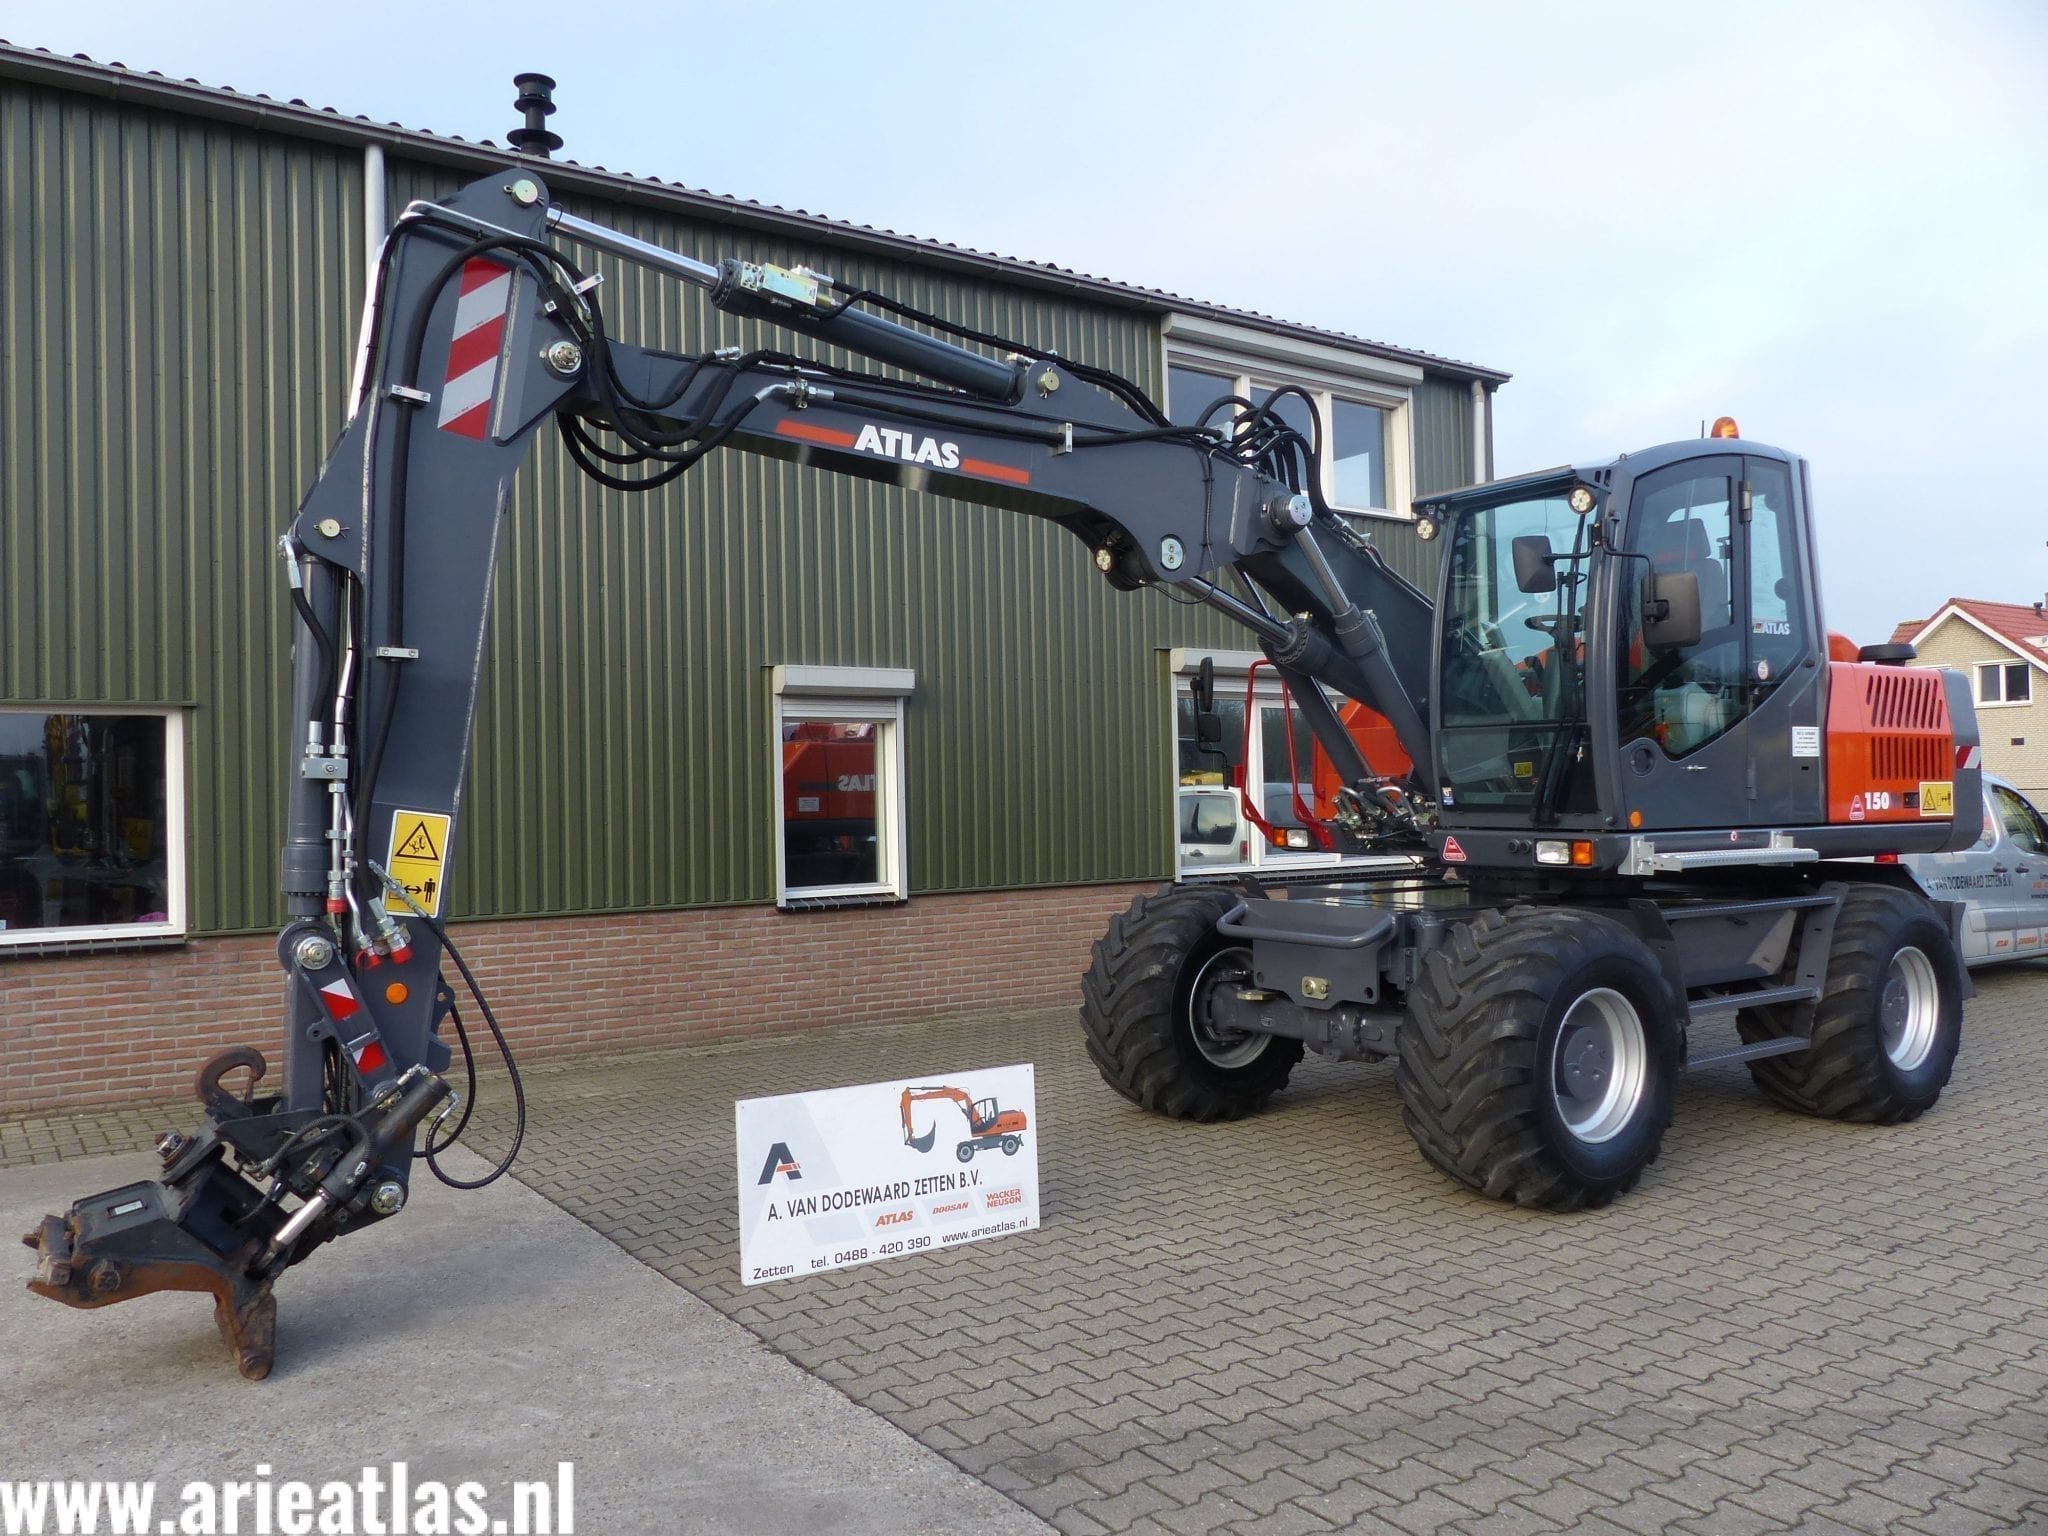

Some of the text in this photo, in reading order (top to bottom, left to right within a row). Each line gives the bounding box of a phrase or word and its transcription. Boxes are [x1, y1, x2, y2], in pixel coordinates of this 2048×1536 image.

[854, 424, 960, 469] ATLAS
[1761, 622, 1790, 635] ATLAS
[1864, 791, 1890, 810] 150
[1948, 875, 1984, 890] DODEWAARD
[767, 1169, 983, 1222] A. VAN DODEWAARD ZETTEN B.V.
[986, 1188, 1021, 1202] WACKER
[987, 1196, 1022, 1209] NEUSON
[932, 1202, 969, 1215] DOOSAN
[875, 1210, 913, 1227] ATLAS
[753, 1263, 794, 1280] Zetten
[811, 1256, 830, 1269] tel.
[834, 1248, 868, 1264] 0488
[879, 1241, 903, 1256] 420
[907, 1236, 931, 1250] 390
[942, 1216, 1028, 1244] www.arieatlas.nl
